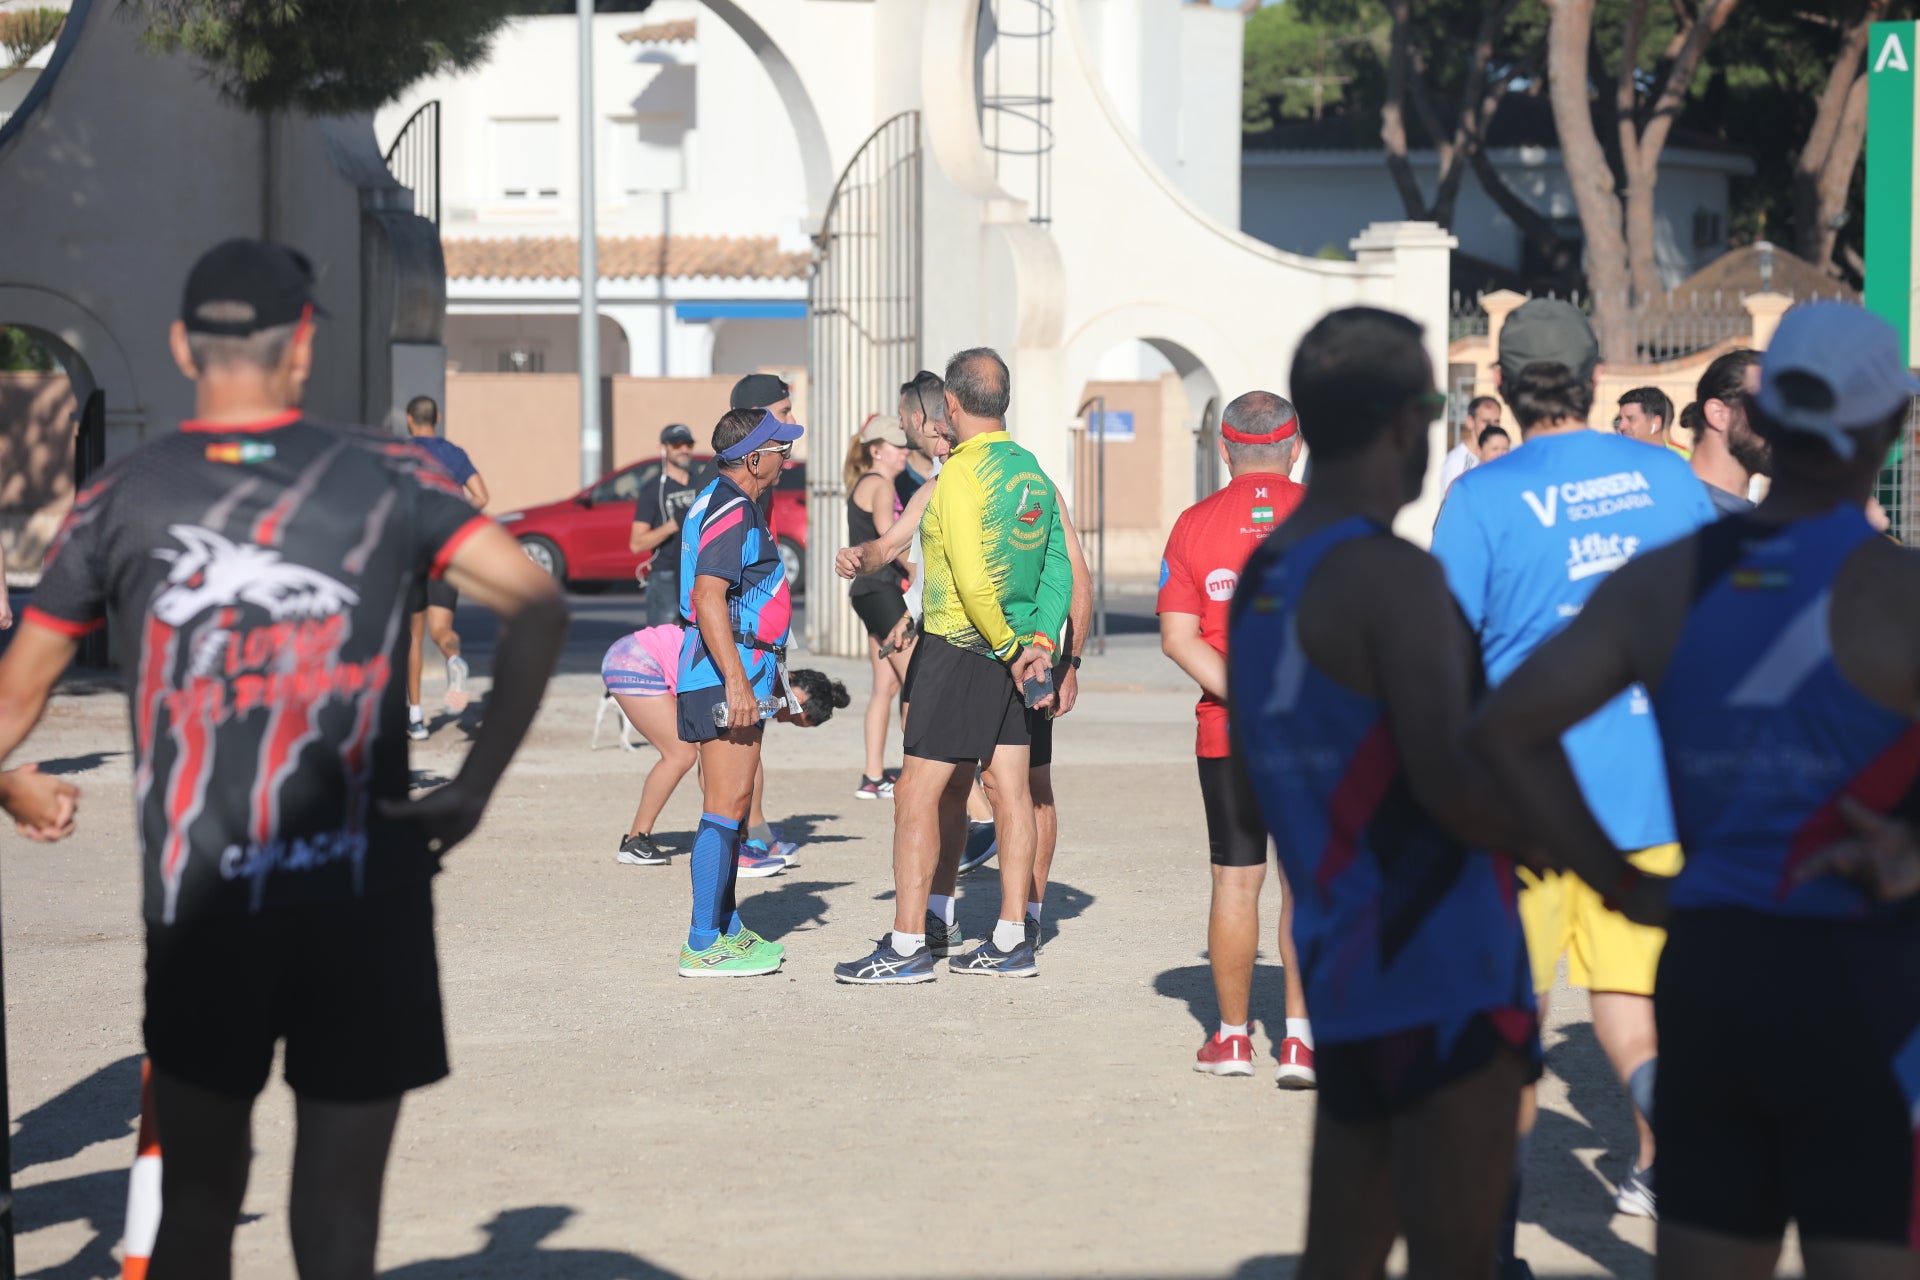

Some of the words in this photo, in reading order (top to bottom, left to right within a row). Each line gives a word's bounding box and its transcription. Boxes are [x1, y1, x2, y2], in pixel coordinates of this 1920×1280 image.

[1521, 485, 1559, 528] V
[1560, 470, 1651, 504] CARRERA
[1566, 492, 1656, 522] SOLIDARIA
